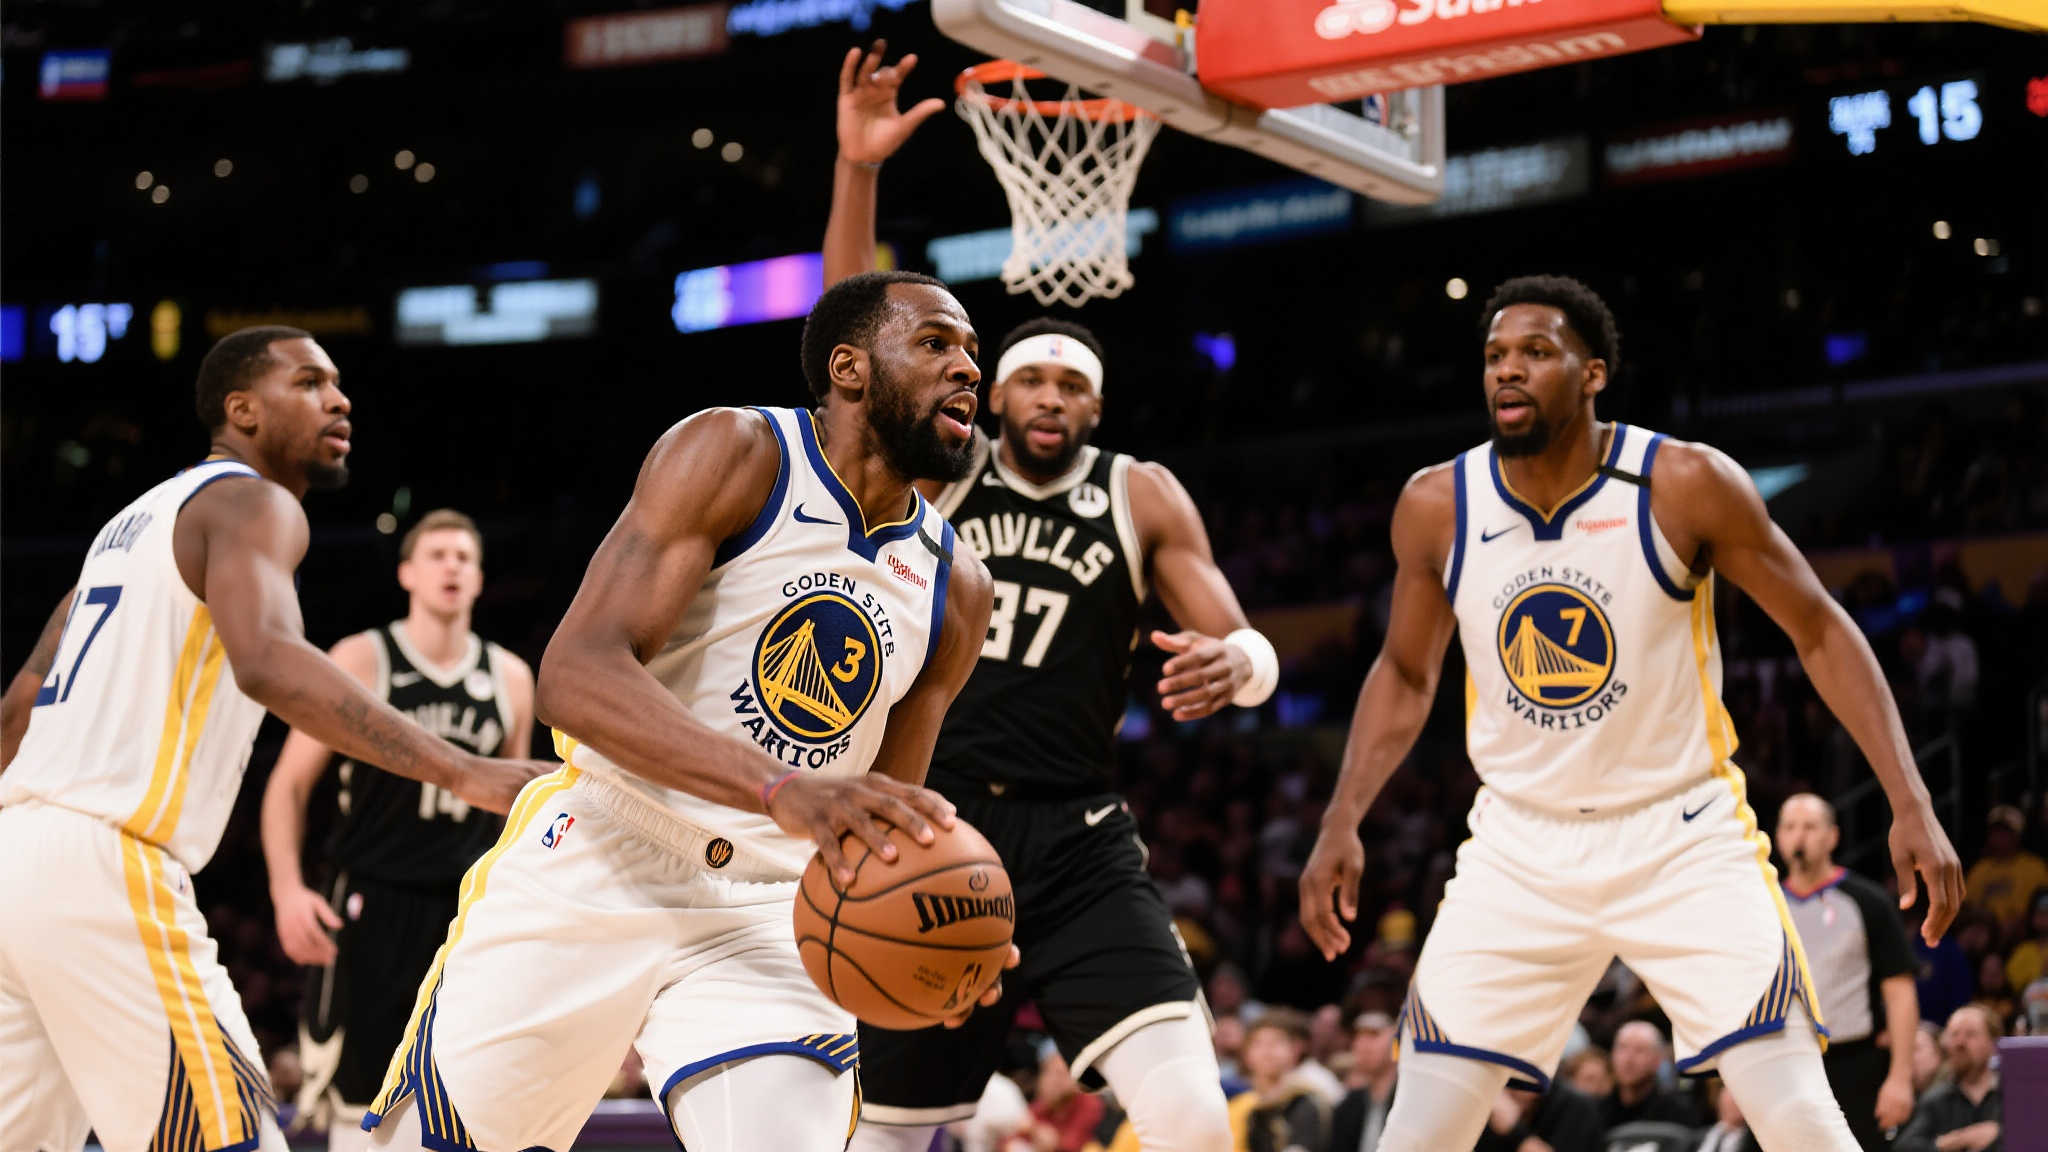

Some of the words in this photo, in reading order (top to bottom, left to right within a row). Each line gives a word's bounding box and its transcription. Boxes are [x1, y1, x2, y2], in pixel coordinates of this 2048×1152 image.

[1908, 79, 1983, 146] 15
[782, 572, 856, 597] GODEN
[1559, 606, 1588, 646] 7
[831, 636, 866, 683] 3
